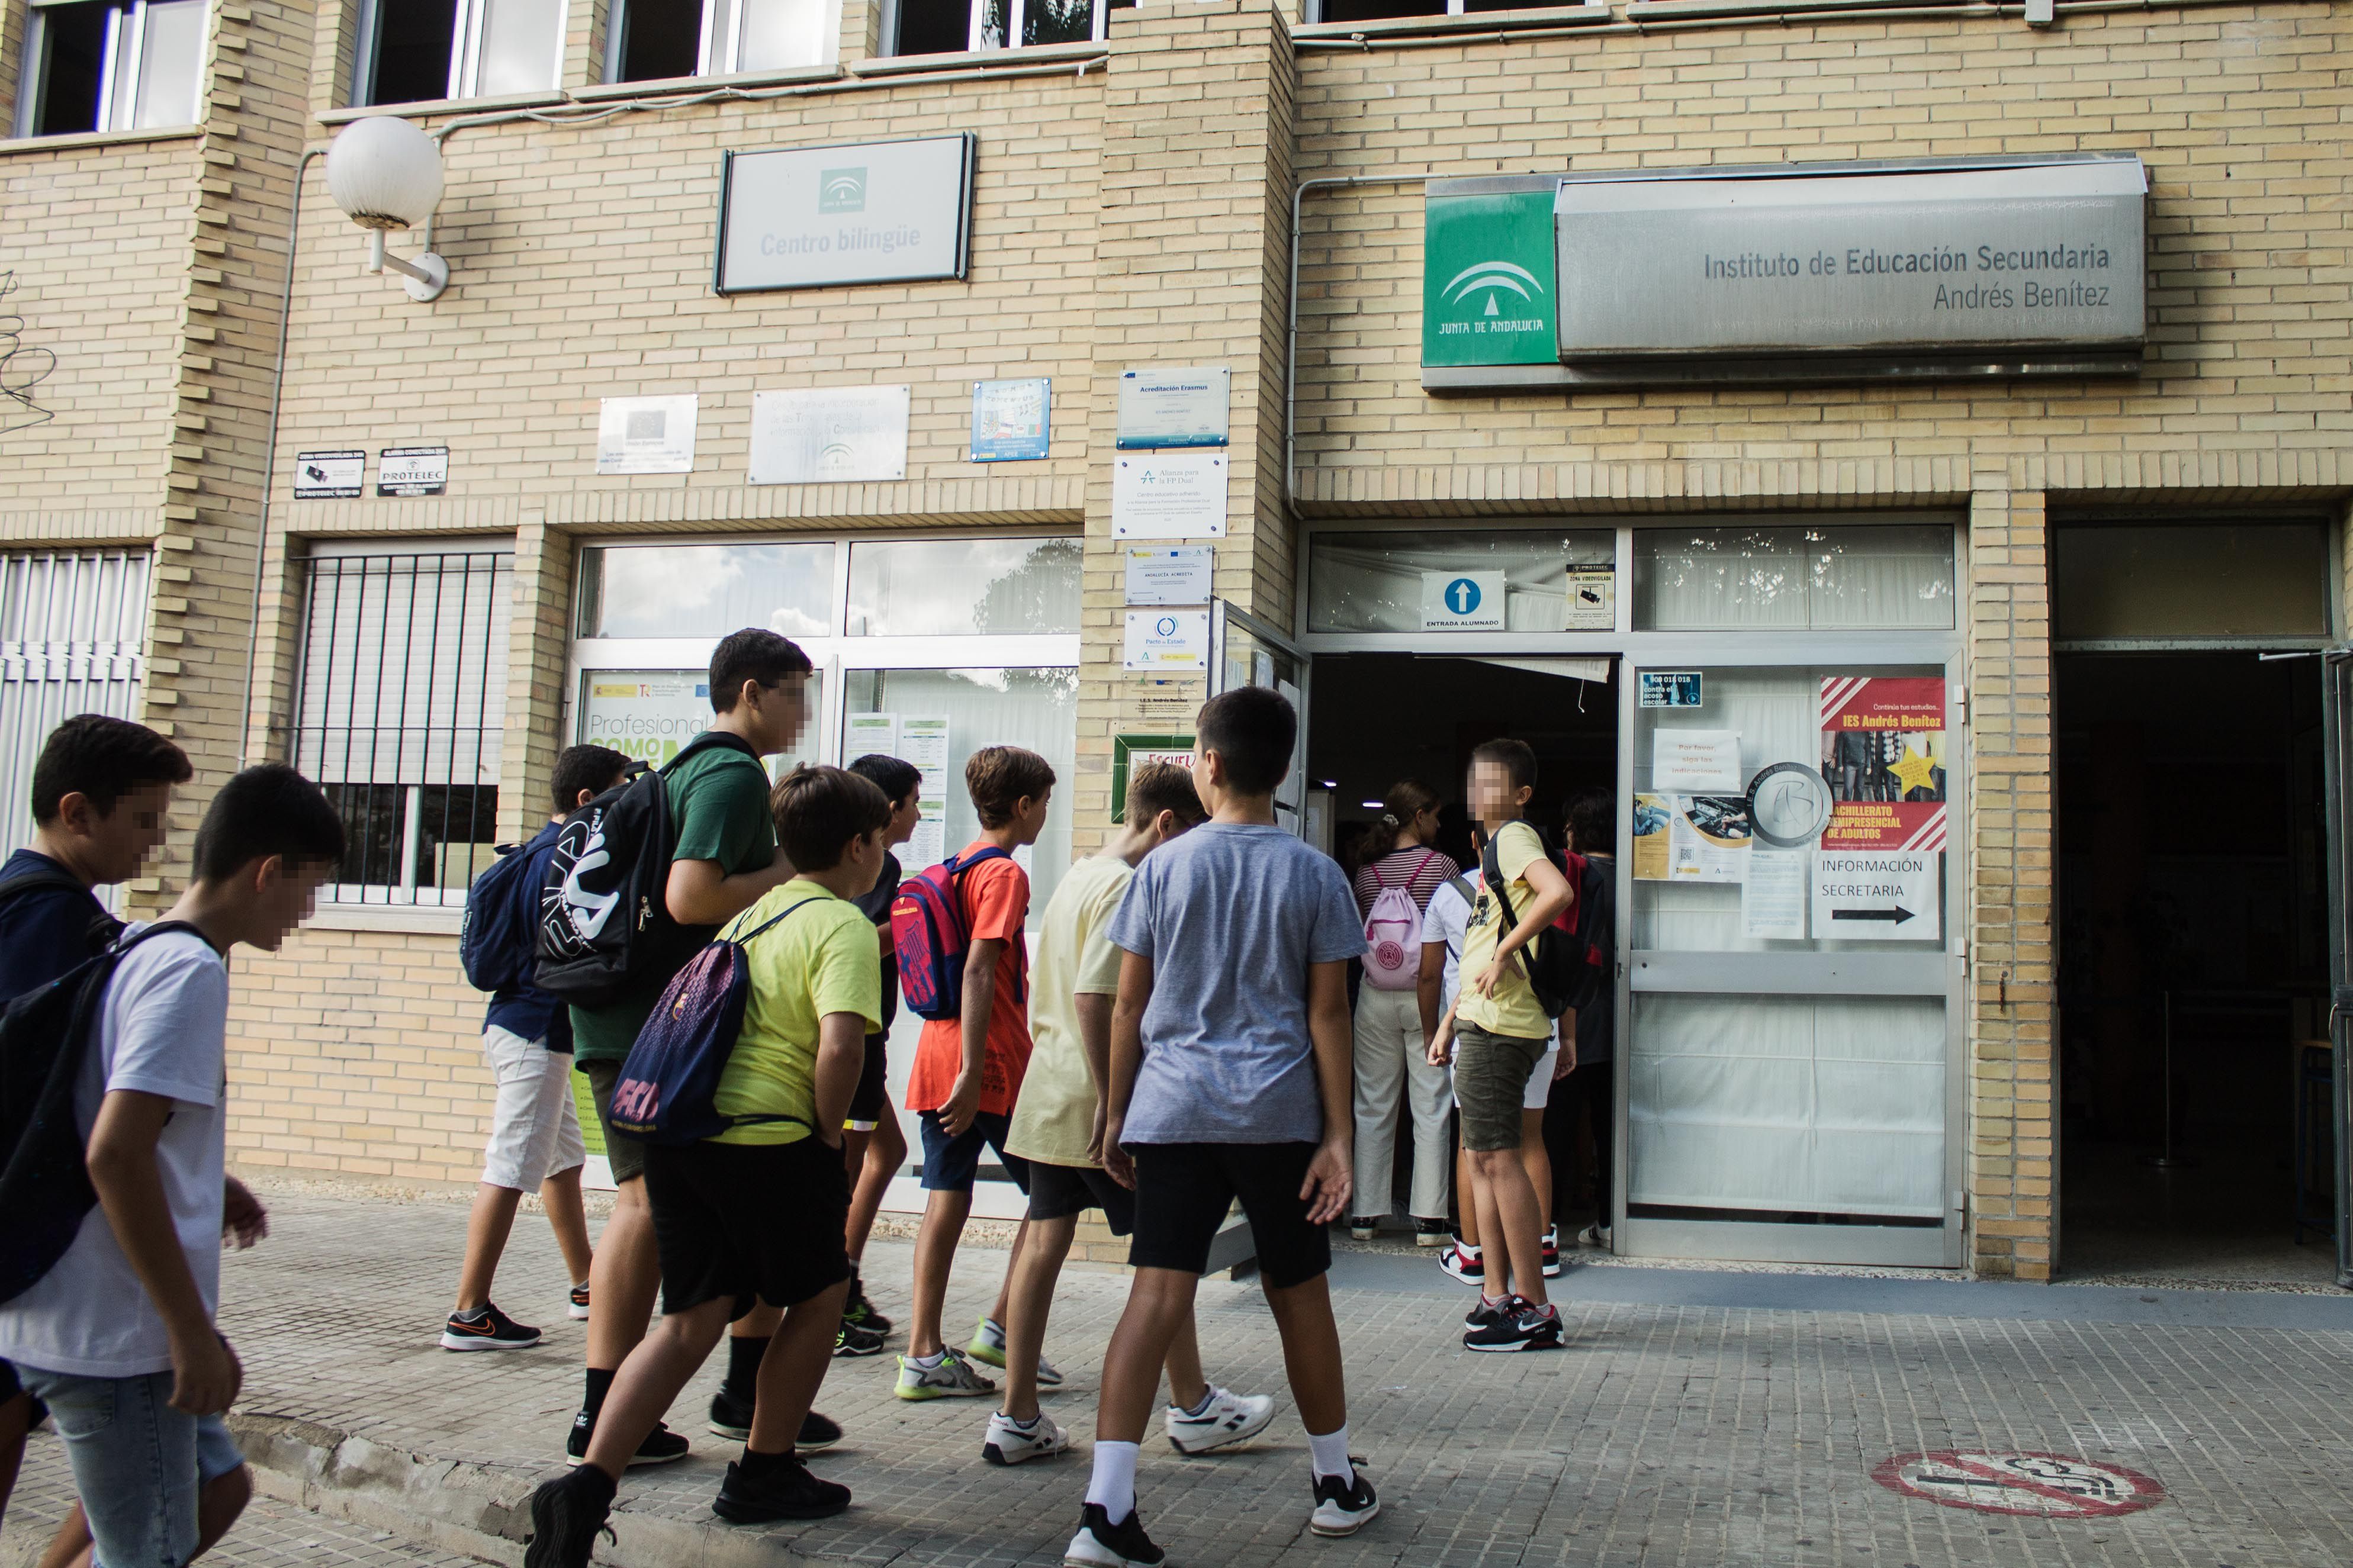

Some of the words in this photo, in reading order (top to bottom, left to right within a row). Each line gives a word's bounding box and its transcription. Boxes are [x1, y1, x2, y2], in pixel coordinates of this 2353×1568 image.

[761, 233, 831, 256] Centro
[837, 224, 921, 253] bilingüe
[1705, 252, 1799, 279] Instituto
[1808, 250, 1837, 276] de
[1846, 246, 1967, 275] Educación
[1977, 243, 2110, 272] Secundaria
[1933, 282, 2014, 310] Andrés
[2024, 279, 2110, 308] Benítez
[1439, 322, 1470, 334] JUNTA
[1474, 321, 1486, 333] DE
[382, 471, 443, 481] PROTELEC
[591, 713, 709, 735] Profesional
[1843, 715, 1859, 727] IES
[1862, 714, 1899, 727] Andrés
[1901, 714, 1941, 727] Benítez
[1754, 769, 1773, 787] Andrés
[1774, 764, 1798, 772] Benítez
[1834, 806, 1893, 816] ACHILLERATO
[1827, 828, 1839, 839] DE
[1840, 828, 1881, 839] ADULTOS
[1822, 857, 1923, 872] INFORMACIÓN
[1821, 885, 1904, 897] SECRETARIA
